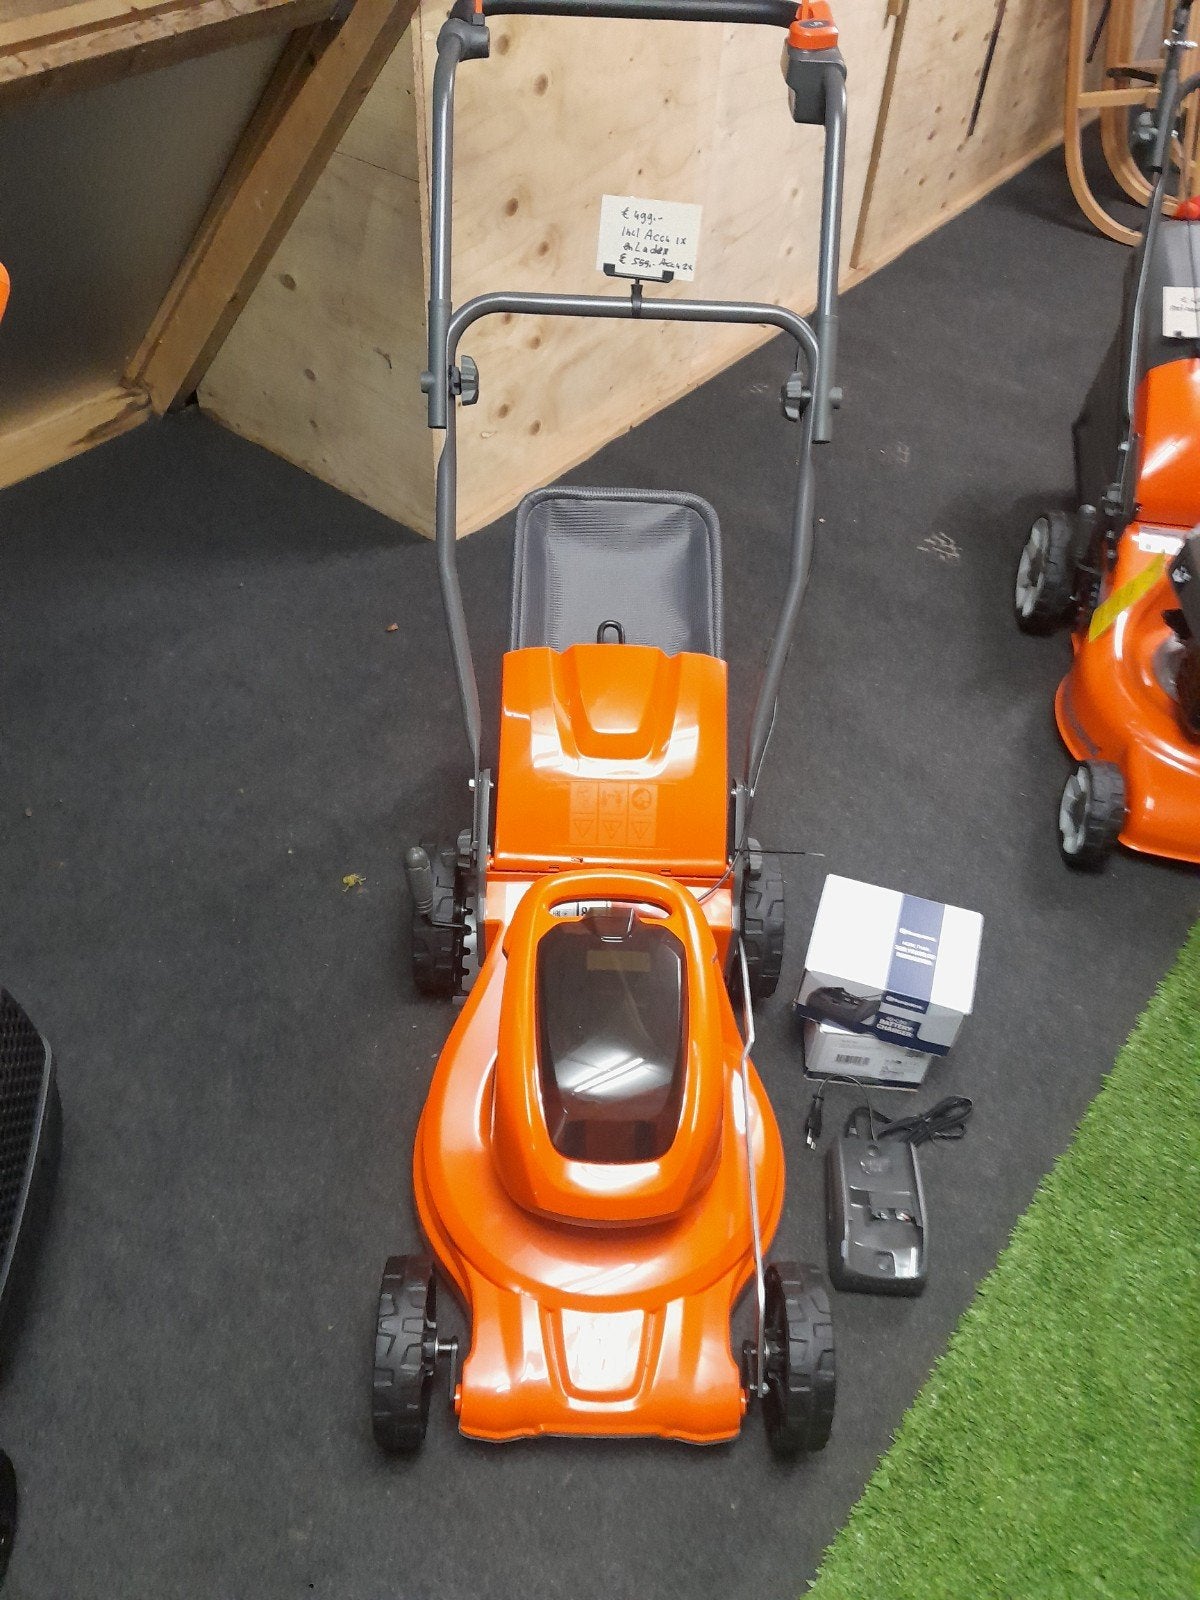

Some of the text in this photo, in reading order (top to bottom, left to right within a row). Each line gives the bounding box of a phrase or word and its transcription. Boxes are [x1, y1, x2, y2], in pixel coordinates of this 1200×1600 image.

[621, 206, 629, 220] €
[618, 253, 627, 265] €
[876, 1023, 914, 1039] CHARGER
[879, 1018, 914, 1033] BATTERY
